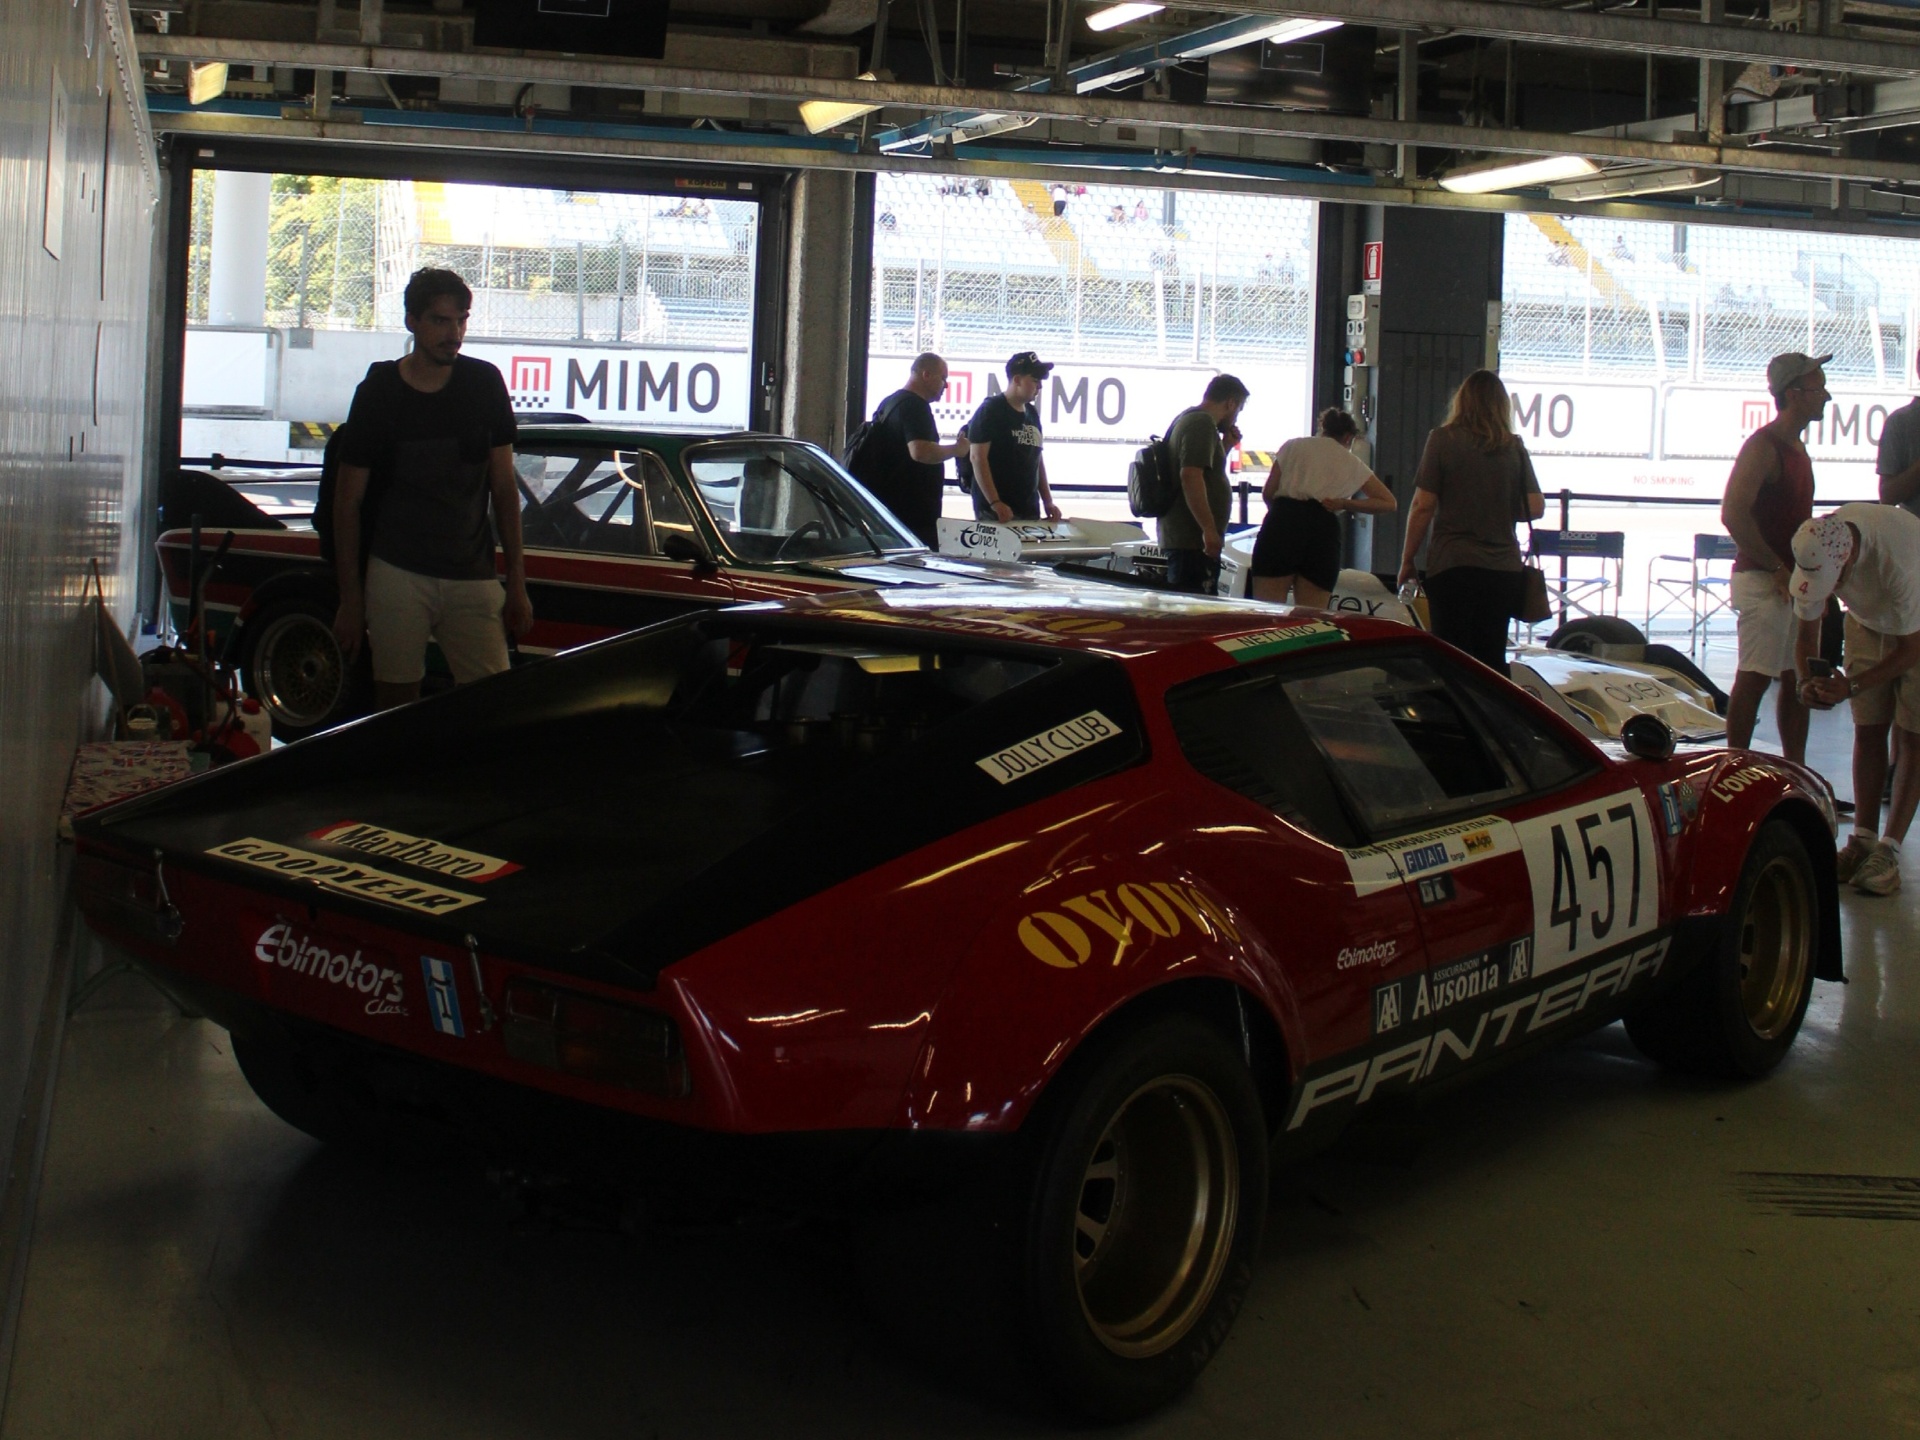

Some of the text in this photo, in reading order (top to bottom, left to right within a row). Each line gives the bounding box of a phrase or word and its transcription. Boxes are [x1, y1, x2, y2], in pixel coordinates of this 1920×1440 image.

[566, 358, 720, 413] MIMO
[1633, 475, 1648, 485] NO
[1650, 475, 1695, 486] SMOKING
[1236, 625, 1316, 647] NETTUNO
[991, 716, 1110, 779] JOLLY CLUB
[219, 844, 462, 908] GOODYEAR
[327, 826, 485, 875] Marlboro
[1405, 846, 1447, 871] FIAT
[1550, 802, 1640, 952] 457
[255, 924, 404, 1002] Ebimotors
[1412, 954, 1499, 1021] Ausonia
[1433, 957, 1480, 982] ASSICURAZIONI
[1286, 935, 1672, 1132] PANTERA
